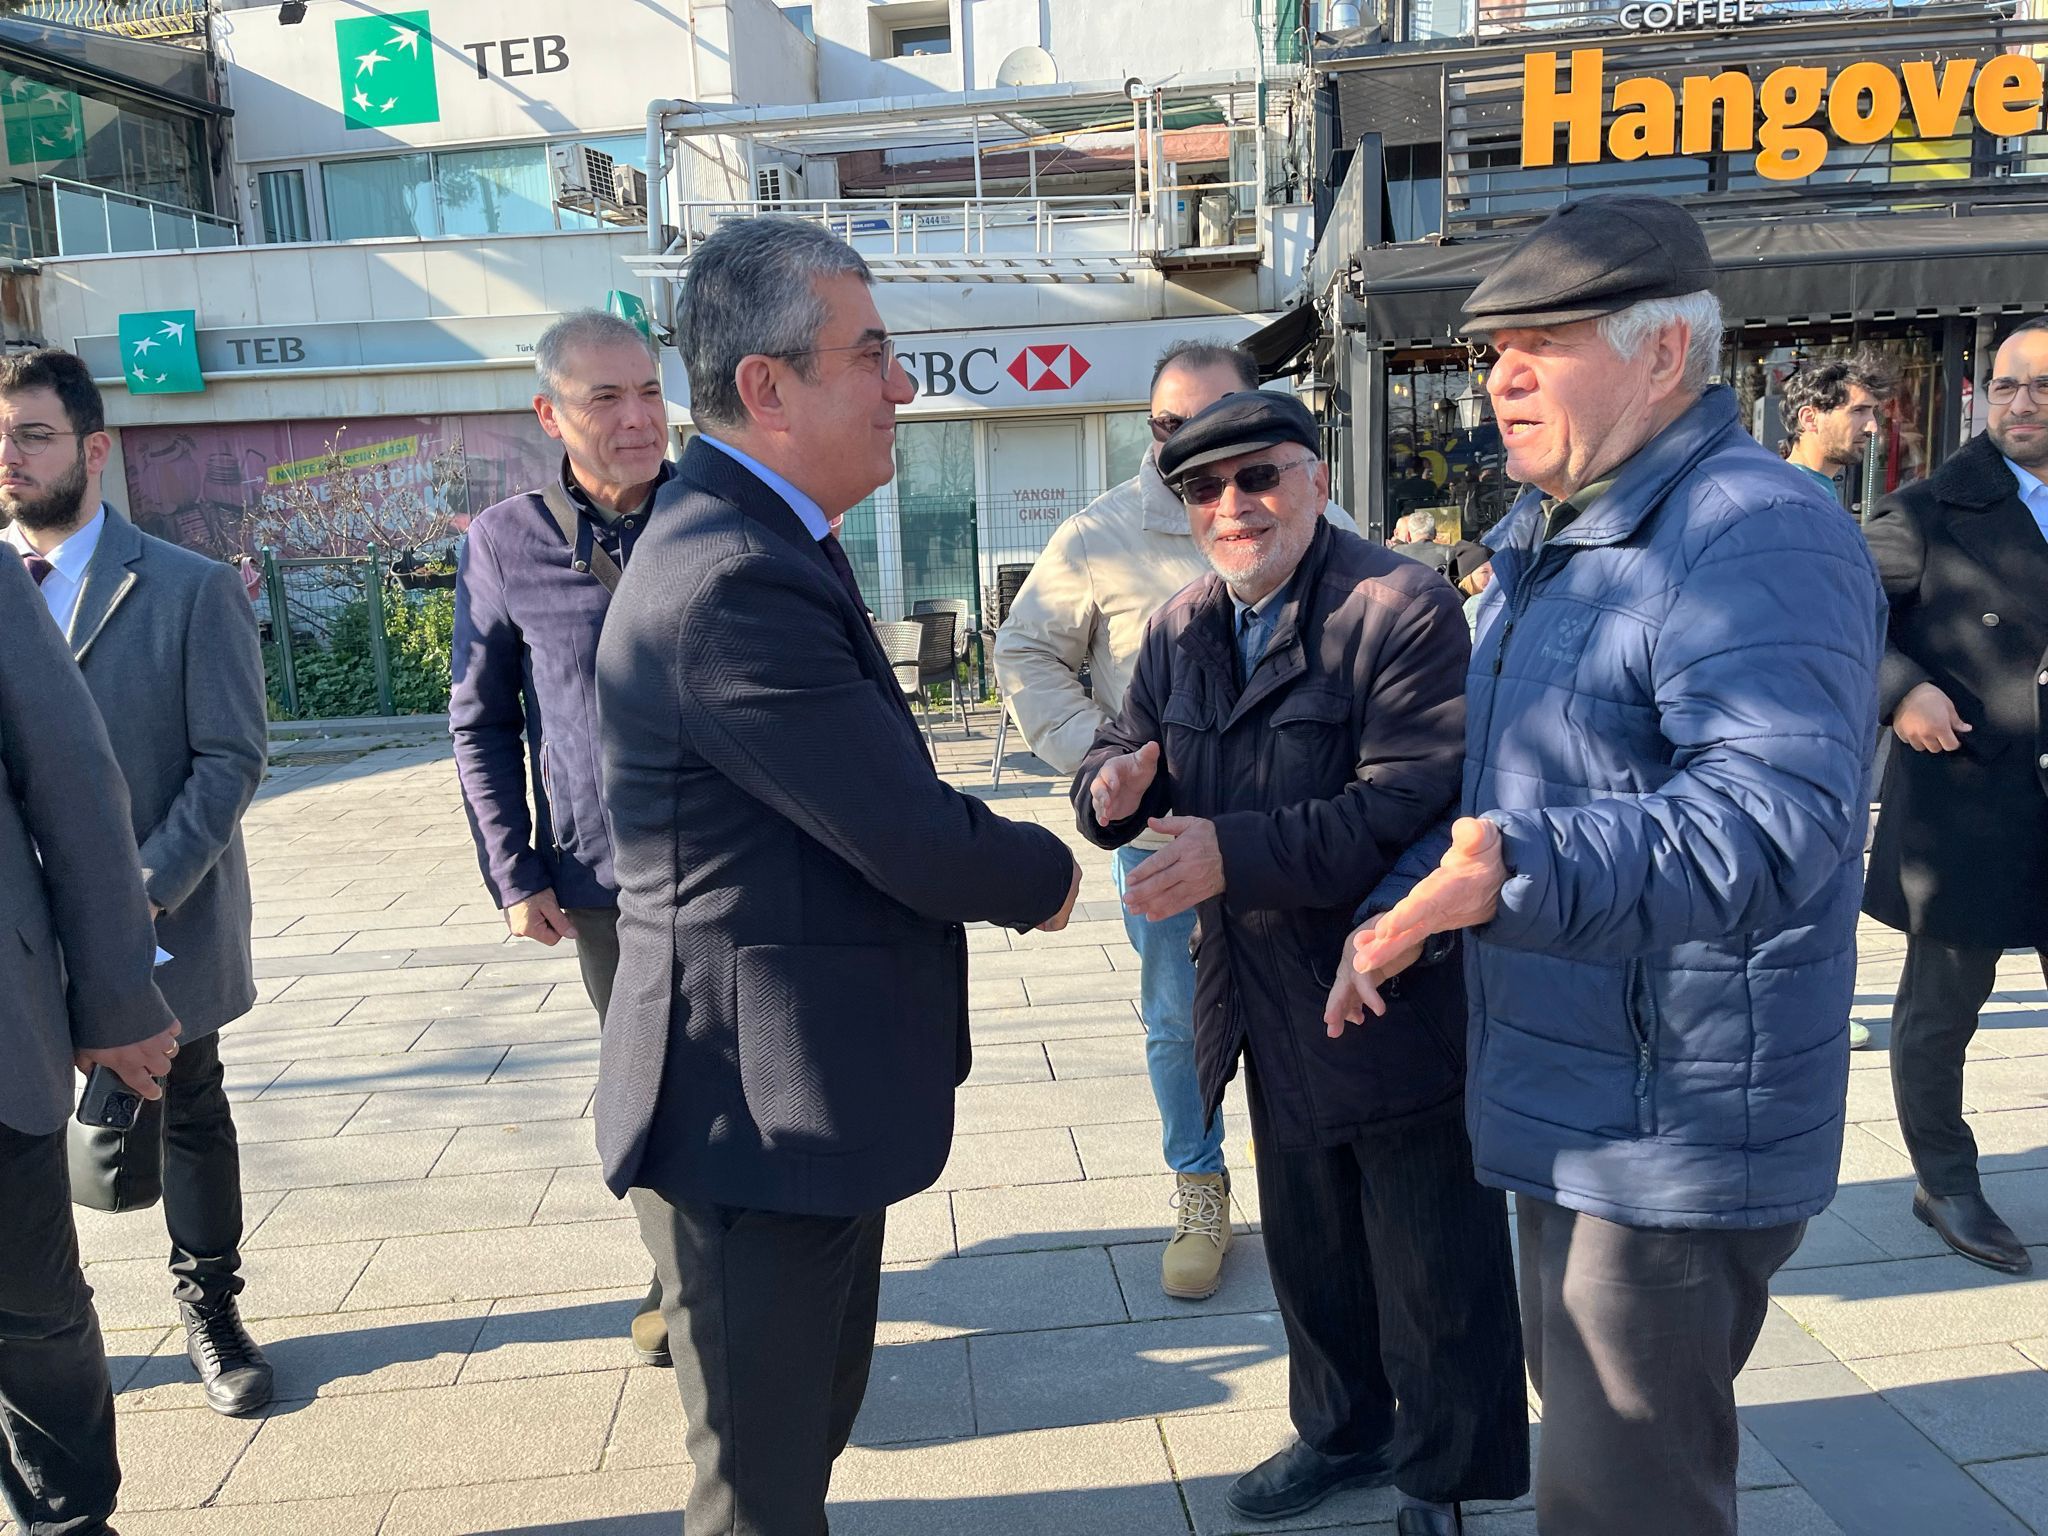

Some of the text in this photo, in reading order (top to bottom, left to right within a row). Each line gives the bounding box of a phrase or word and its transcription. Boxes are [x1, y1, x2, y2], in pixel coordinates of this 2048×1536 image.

[1619, 0, 1753, 29] COFFEE
[463, 34, 570, 80] TEB
[1521, 48, 2043, 180] Hangove
[226, 336, 306, 365] TEB
[515, 343, 535, 353] Türk
[1013, 487, 1065, 501] YANGIN
[1019, 507, 1060, 524] ÇIKIŞI
